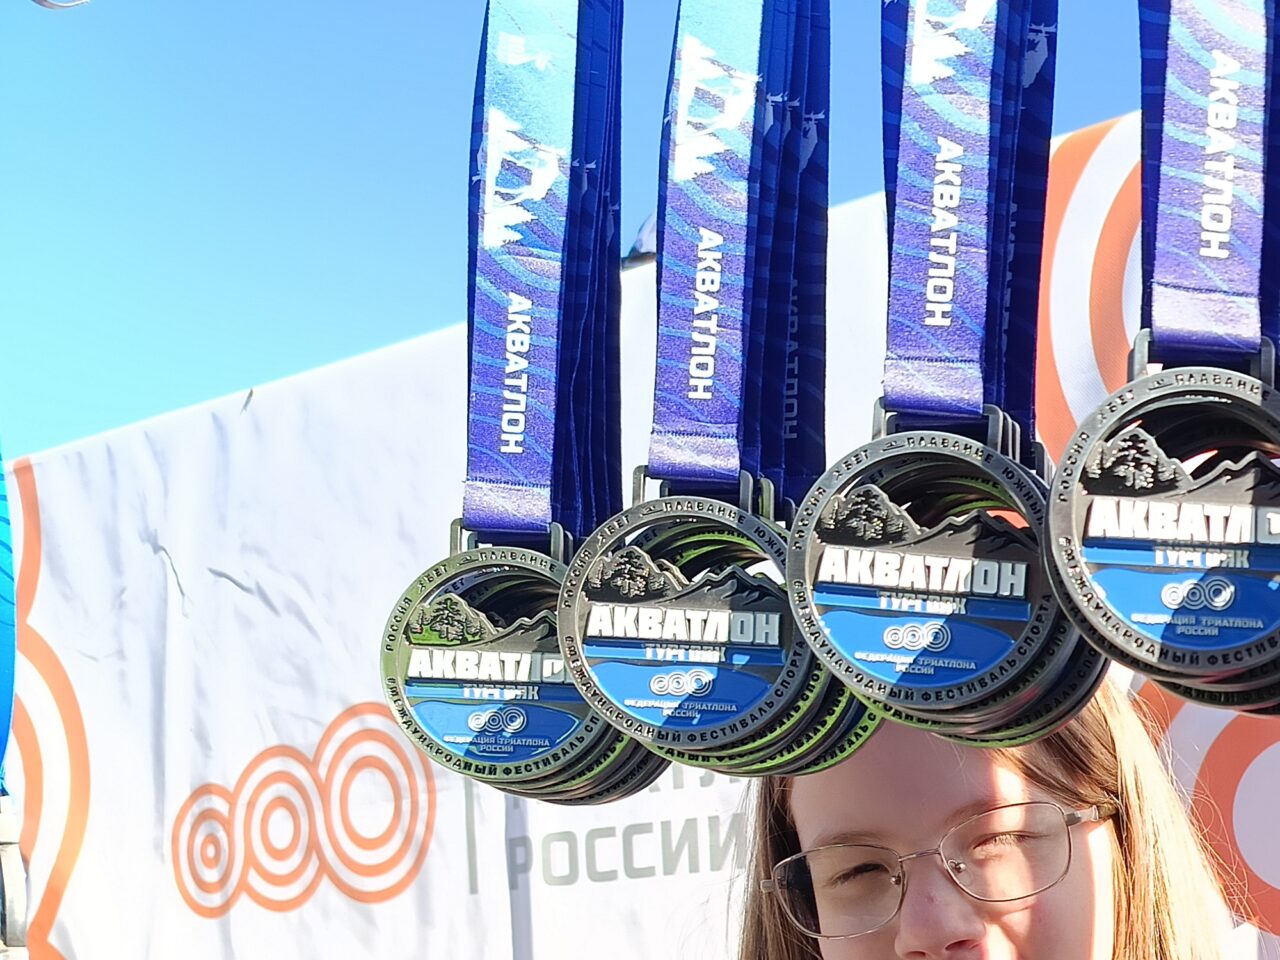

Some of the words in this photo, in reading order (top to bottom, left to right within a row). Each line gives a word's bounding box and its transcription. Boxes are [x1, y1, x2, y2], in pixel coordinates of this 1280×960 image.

[1199, 49, 1241, 259] АКВАТЛОН
[924, 136, 964, 327] АКВАТЛОН
[687, 226, 724, 400] АКВАТЛОН
[500, 291, 532, 454] АКВАТЛОН
[605, 513, 631, 535] БЕГ
[661, 499, 746, 524] ПЛАВАНИЕ
[423, 562, 449, 583] БЕГ
[477, 549, 558, 573] ПЛАВАНИЕ
[561, 548, 592, 608] РОССИЯ
[820, 546, 1027, 597] АКВАТЛОН
[384, 595, 413, 651] РОССИЯ
[587, 604, 781, 646] АКВАТЛОН
[1176, 625, 1219, 637] РОССИИ
[1201, 617, 1263, 629] ТРИАТЛОНА
[793, 590, 914, 700] МЕЖДУНАРОДНЫЙ
[921, 655, 1018, 702] ФЕСТИВАЛЬ
[1016, 592, 1052, 657] СПОРТА
[917, 657, 976, 669] ТРИАТЛОНА
[565, 644, 680, 742] МЕЖДУНАРОДНЫЙ
[687, 697, 776, 743] ФЕСТИВАЛЬ
[772, 640, 804, 699] СПОРТА
[799, 662, 824, 702] СПОР
[682, 701, 738, 712] ТРИАТЛОНА
[388, 685, 496, 775] МЕЖДУНАРОДНЫЙ
[502, 732, 586, 776] ФЕСТИВАЛЬ
[480, 744, 514, 753] РОССИИ
[497, 736, 550, 746] ТРИАТЛОНА
[509, 812, 748, 891] РОССИИ
